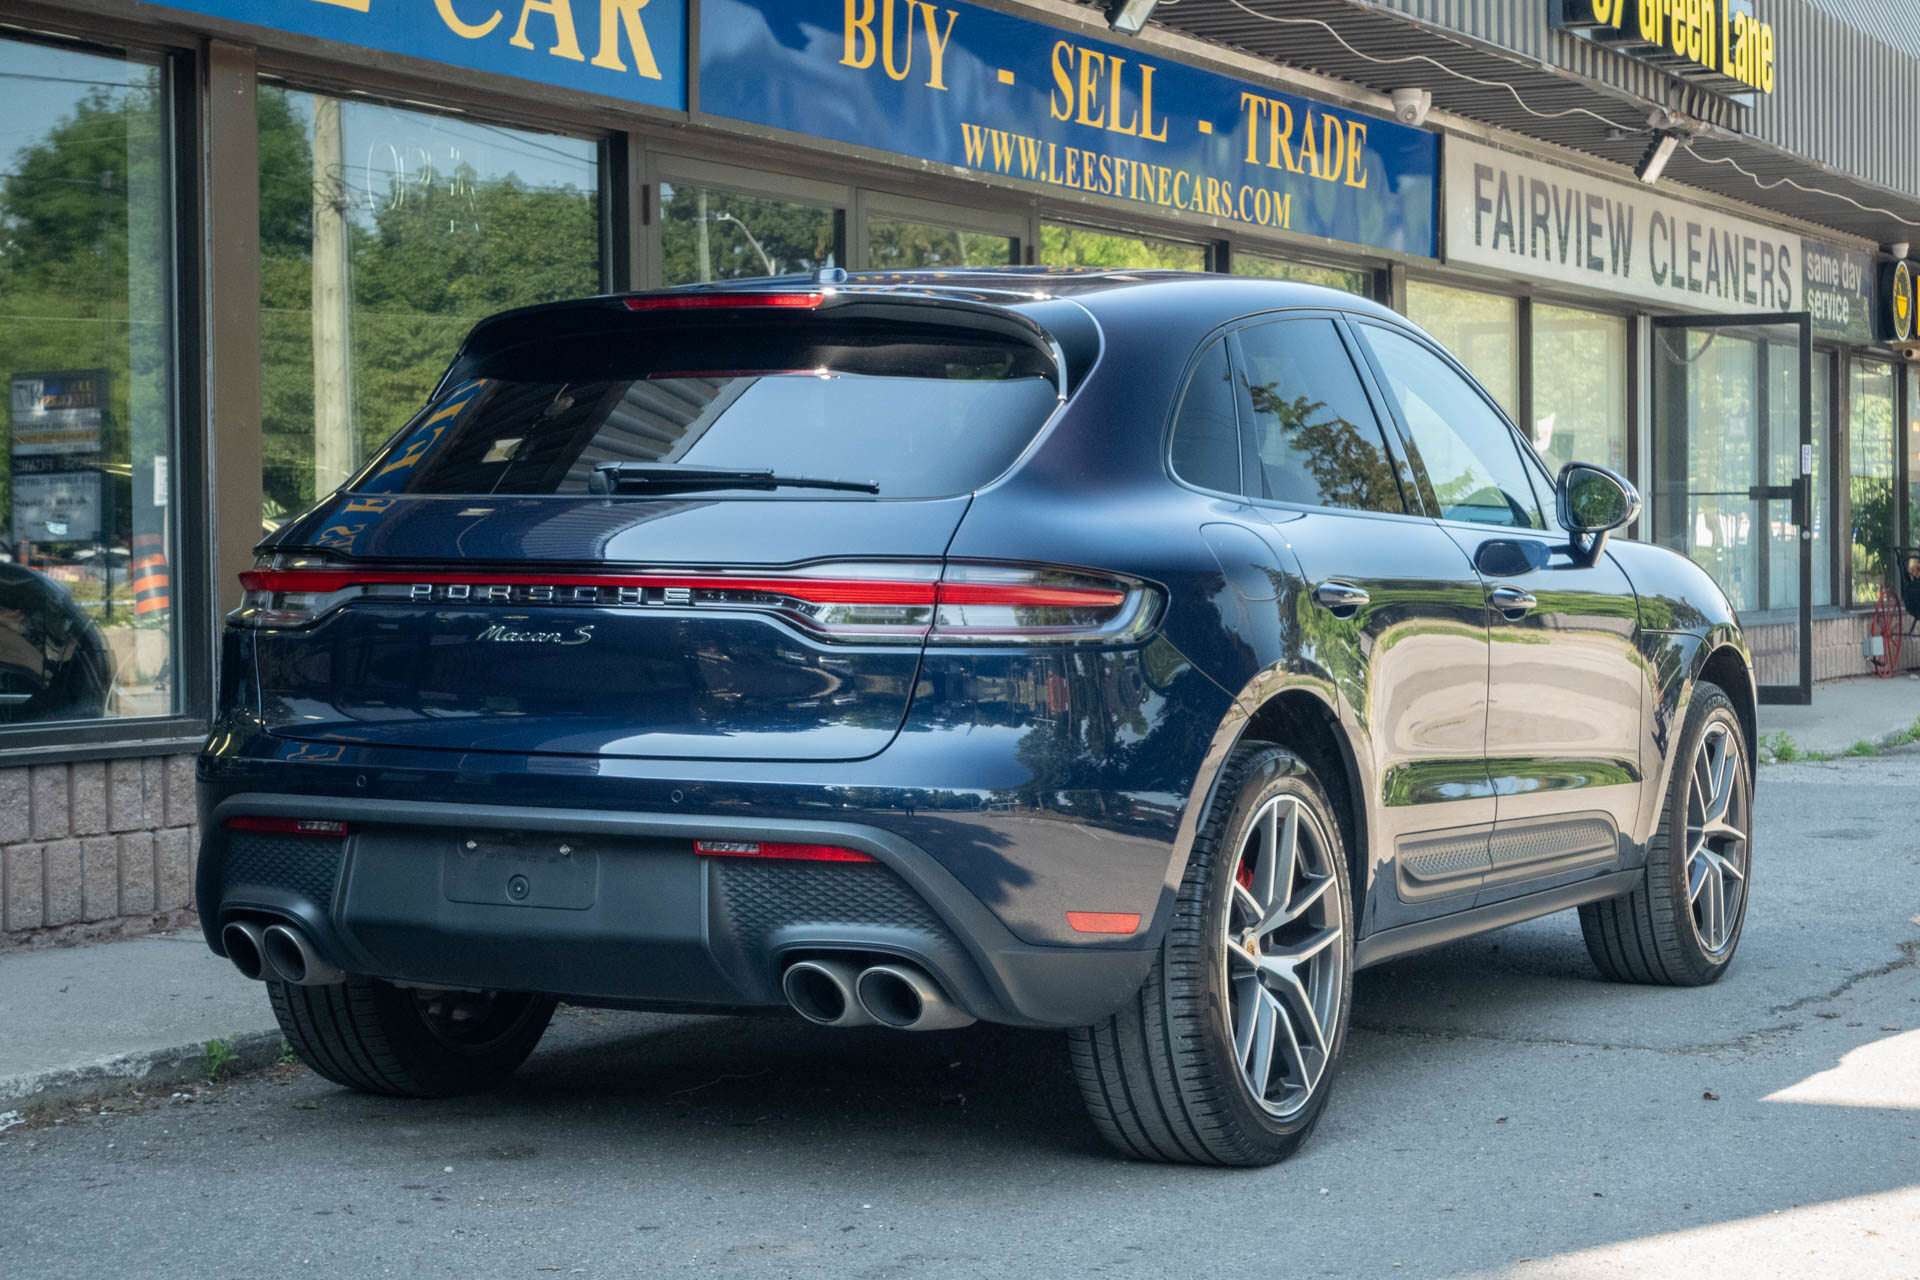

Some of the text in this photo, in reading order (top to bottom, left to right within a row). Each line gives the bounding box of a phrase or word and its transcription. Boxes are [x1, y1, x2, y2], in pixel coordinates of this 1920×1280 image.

[1722, 0, 1774, 95] Lane
[839, 0, 960, 91] BUY
[1051, 40, 1168, 143] SELL
[1241, 91, 1368, 189] TRADE
[960, 123, 1292, 229] WWW.LEESFINECARS.COM
[1474, 163, 1634, 278] FAIRVIEW
[1649, 210, 1792, 312] CLEANERS
[1807, 252, 1862, 299] same day
[1807, 286, 1849, 325] service
[410, 583, 691, 606] PORSCHE
[476, 625, 595, 645] Macan S
